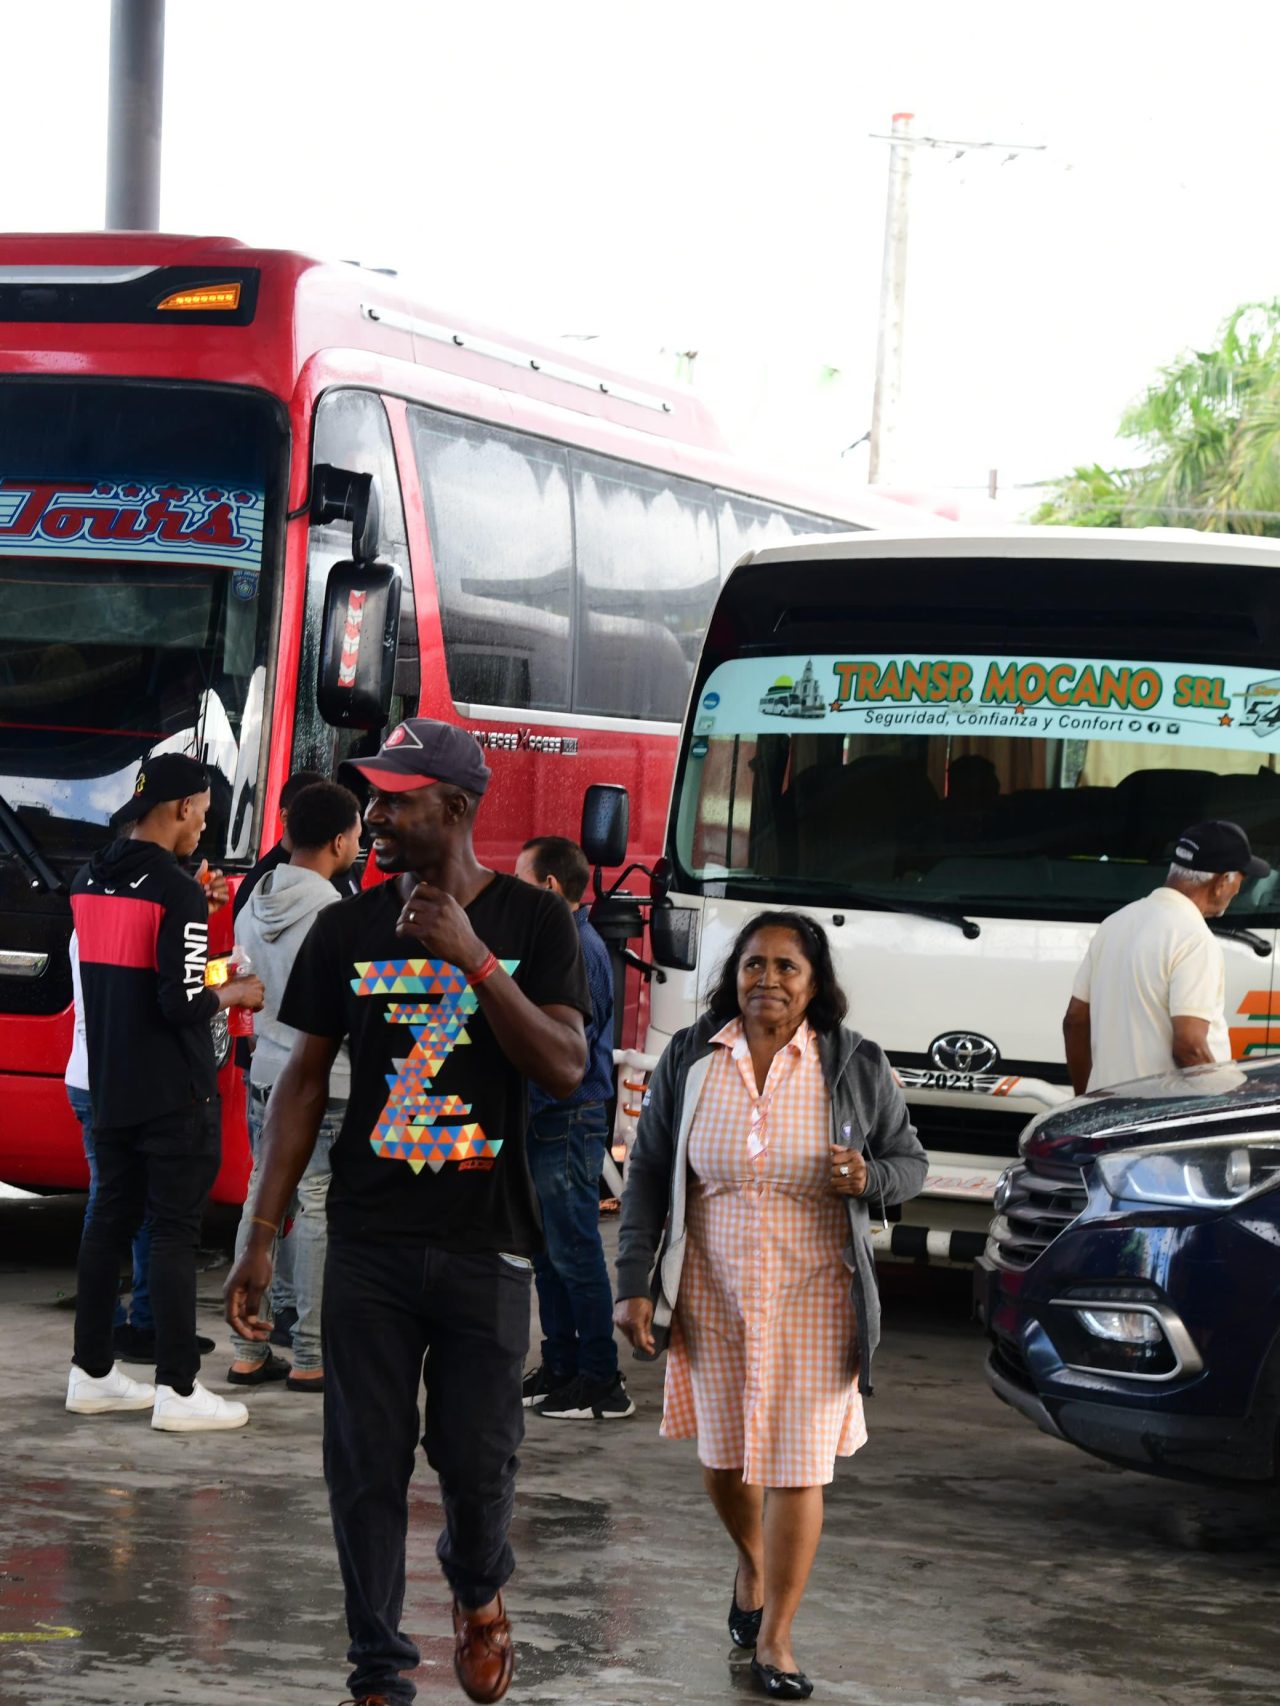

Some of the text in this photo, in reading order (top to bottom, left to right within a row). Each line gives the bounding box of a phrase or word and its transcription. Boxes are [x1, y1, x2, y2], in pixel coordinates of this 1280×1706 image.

[833, 660, 1231, 710] TRANSP. MOCANO SRL
[864, 710, 1123, 731] Seguridad, Confianza y Confort
[921, 1071, 975, 1092] 2023
